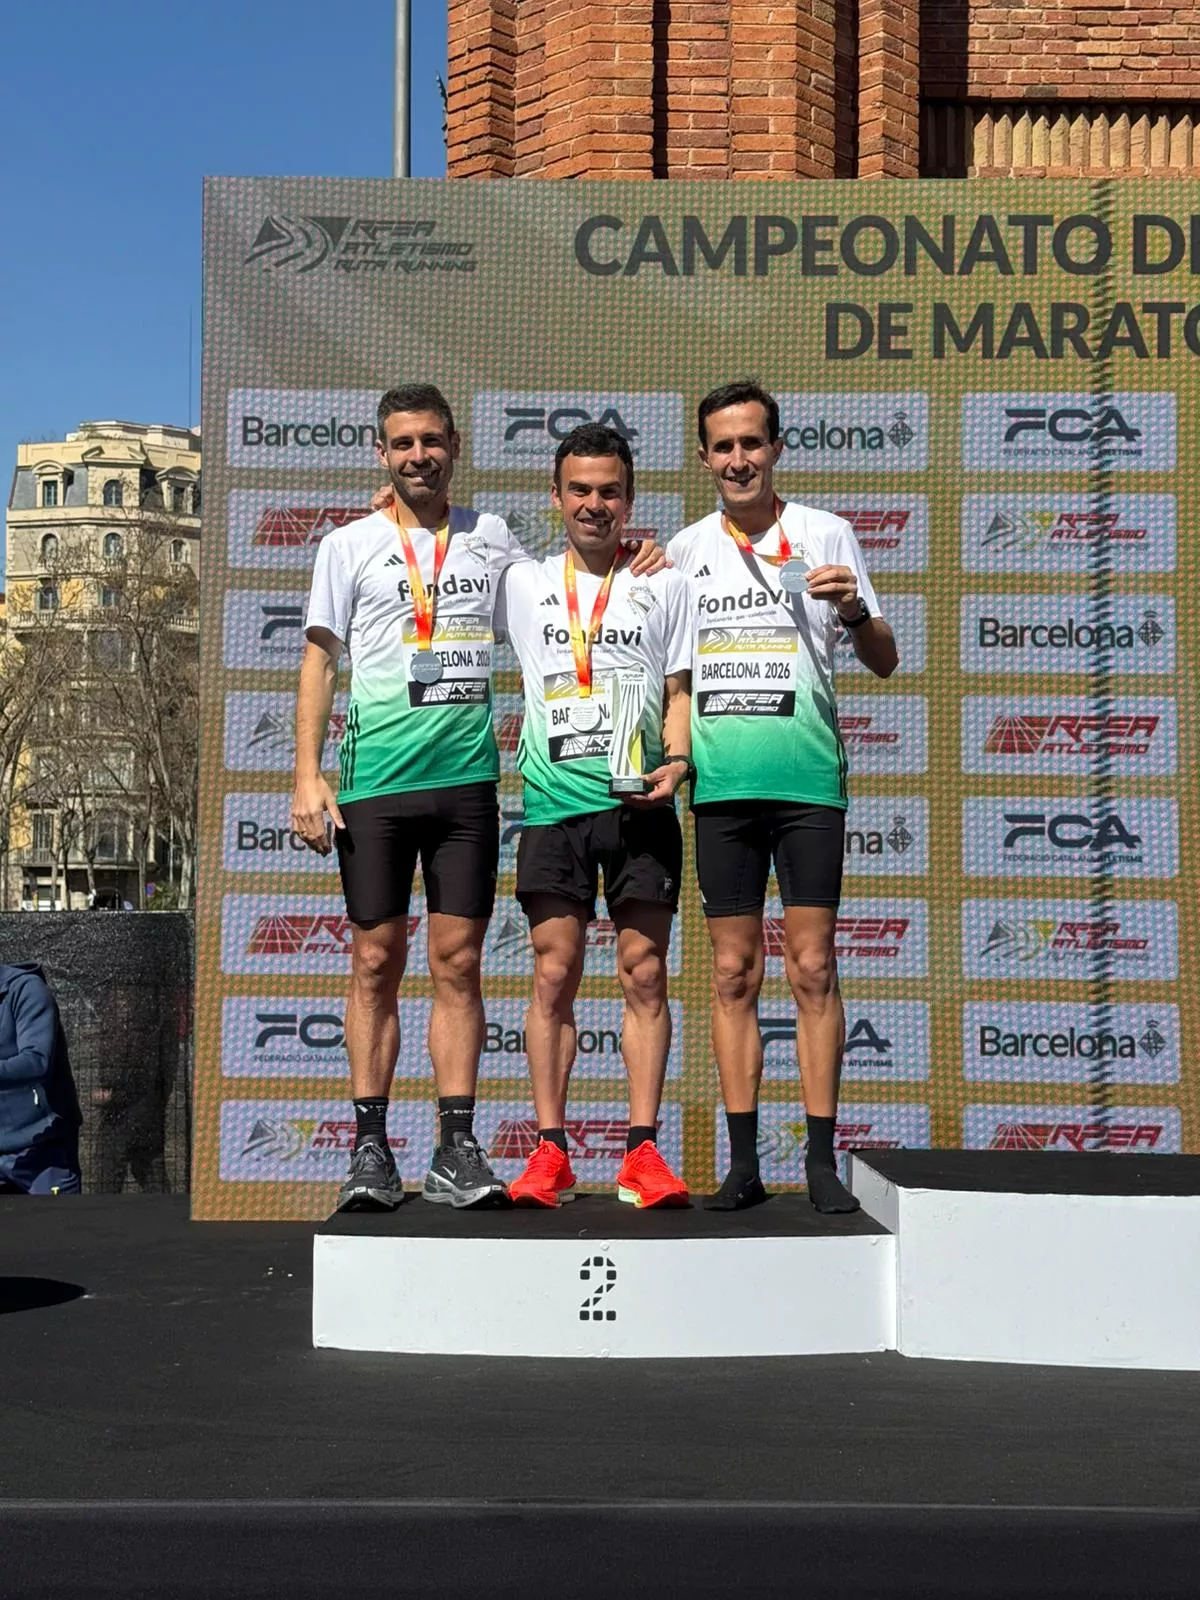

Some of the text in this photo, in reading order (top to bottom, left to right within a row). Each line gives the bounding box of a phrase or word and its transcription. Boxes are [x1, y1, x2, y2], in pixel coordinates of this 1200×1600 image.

[350, 219, 437, 240] RFEA
[340, 242, 475, 256] ATLETISMO
[574, 214, 1200, 277] CAMPEONATO D
[333, 259, 479, 274] RUTA RUNNING
[825, 302, 914, 360] DE
[242, 416, 378, 447] Barcelon
[504, 407, 639, 442] FCA
[779, 419, 885, 450] celona
[1004, 408, 1142, 442] FCA
[834, 511, 910, 531] EA
[397, 573, 491, 602] fndavi
[698, 587, 791, 617] fondavi
[740, 628, 777, 637] RFEA
[978, 617, 1134, 648] Barcelona
[701, 661, 791, 680] BARCELONA 2026
[731, 693, 785, 706] RFEA
[838, 716, 872, 730] EA
[1047, 716, 1160, 742] RFEA
[588, 734, 613, 748] RF
[842, 733, 899, 744] TISMO
[238, 820, 332, 852] Barcl
[1003, 814, 1143, 850] FCA
[835, 918, 910, 940] FEA
[835, 946, 900, 958] ETISMO
[255, 1013, 346, 1049] FC
[482, 1022, 622, 1054] Baron
[758, 1018, 893, 1053] FA
[979, 1025, 1136, 1058] Barcelona
[311, 1137, 408, 1148] ATLEMO
[318, 1121, 357, 1136] RF
[834, 1124, 873, 1137] FEA
[1049, 1123, 1164, 1152] RFEA
[579, 1256, 617, 1321] 2
